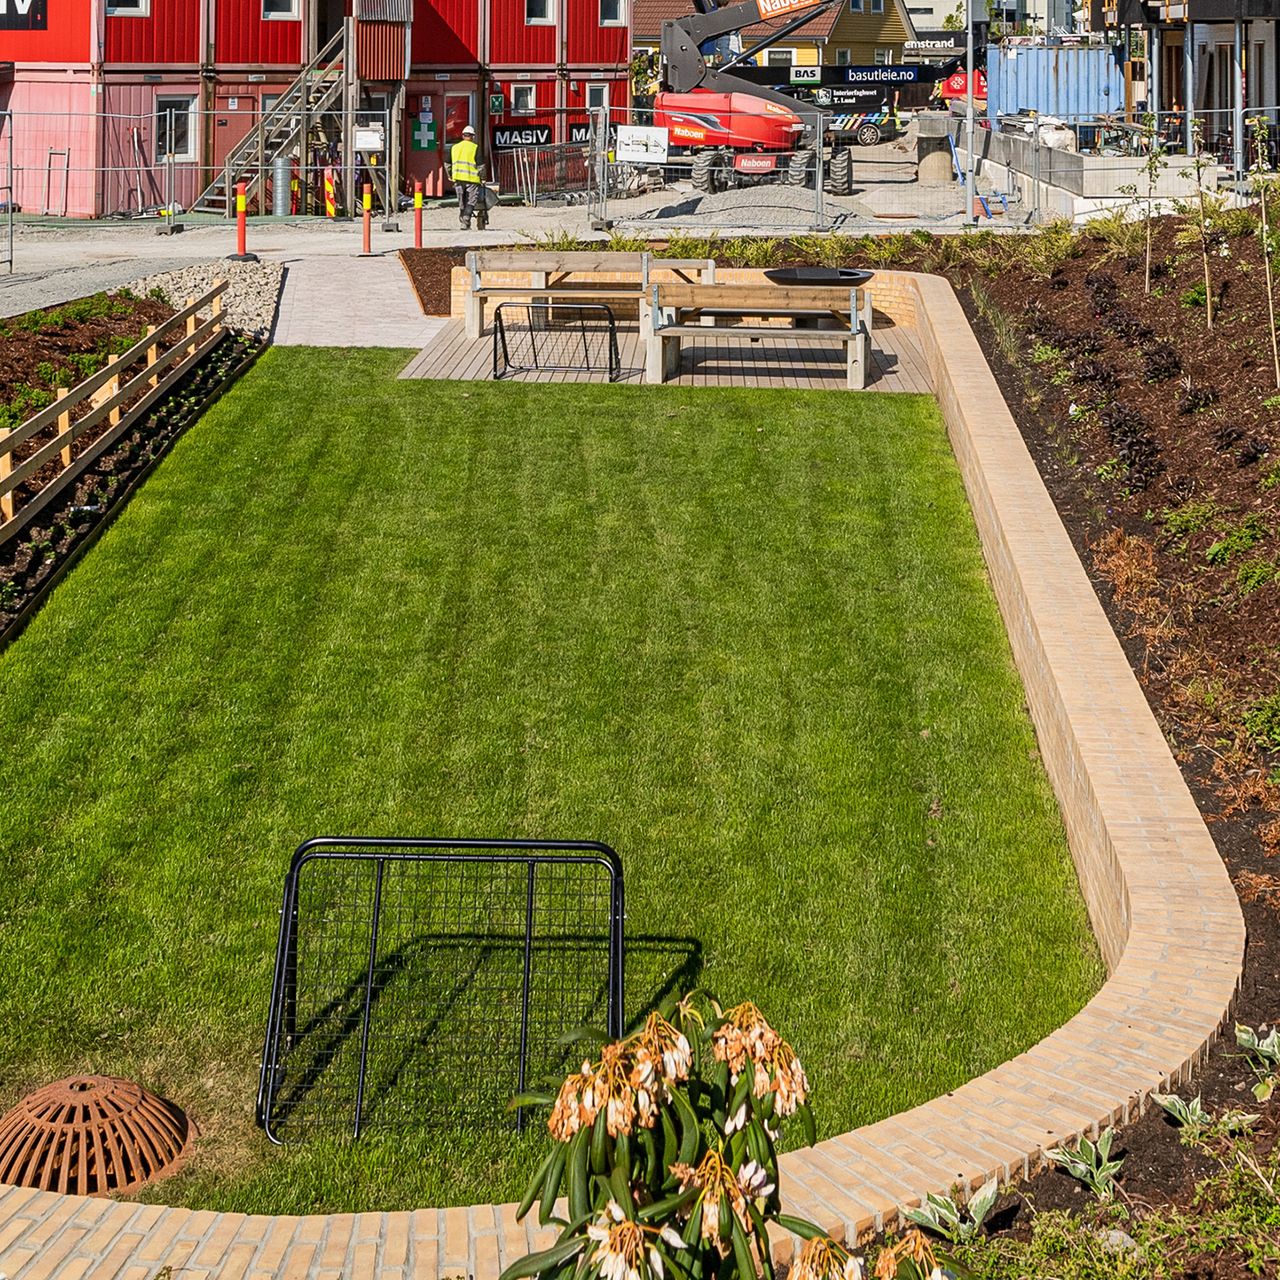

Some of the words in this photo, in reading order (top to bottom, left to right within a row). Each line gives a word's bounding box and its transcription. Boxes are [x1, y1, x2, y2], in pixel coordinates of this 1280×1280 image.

[904, 38, 955, 49] emstrand
[794, 70, 816, 79] BAS
[848, 69, 914, 81] basutleie.no
[495, 129, 549, 145] MASIV
[673, 126, 704, 139] Naboen
[740, 159, 771, 168] Naboen
